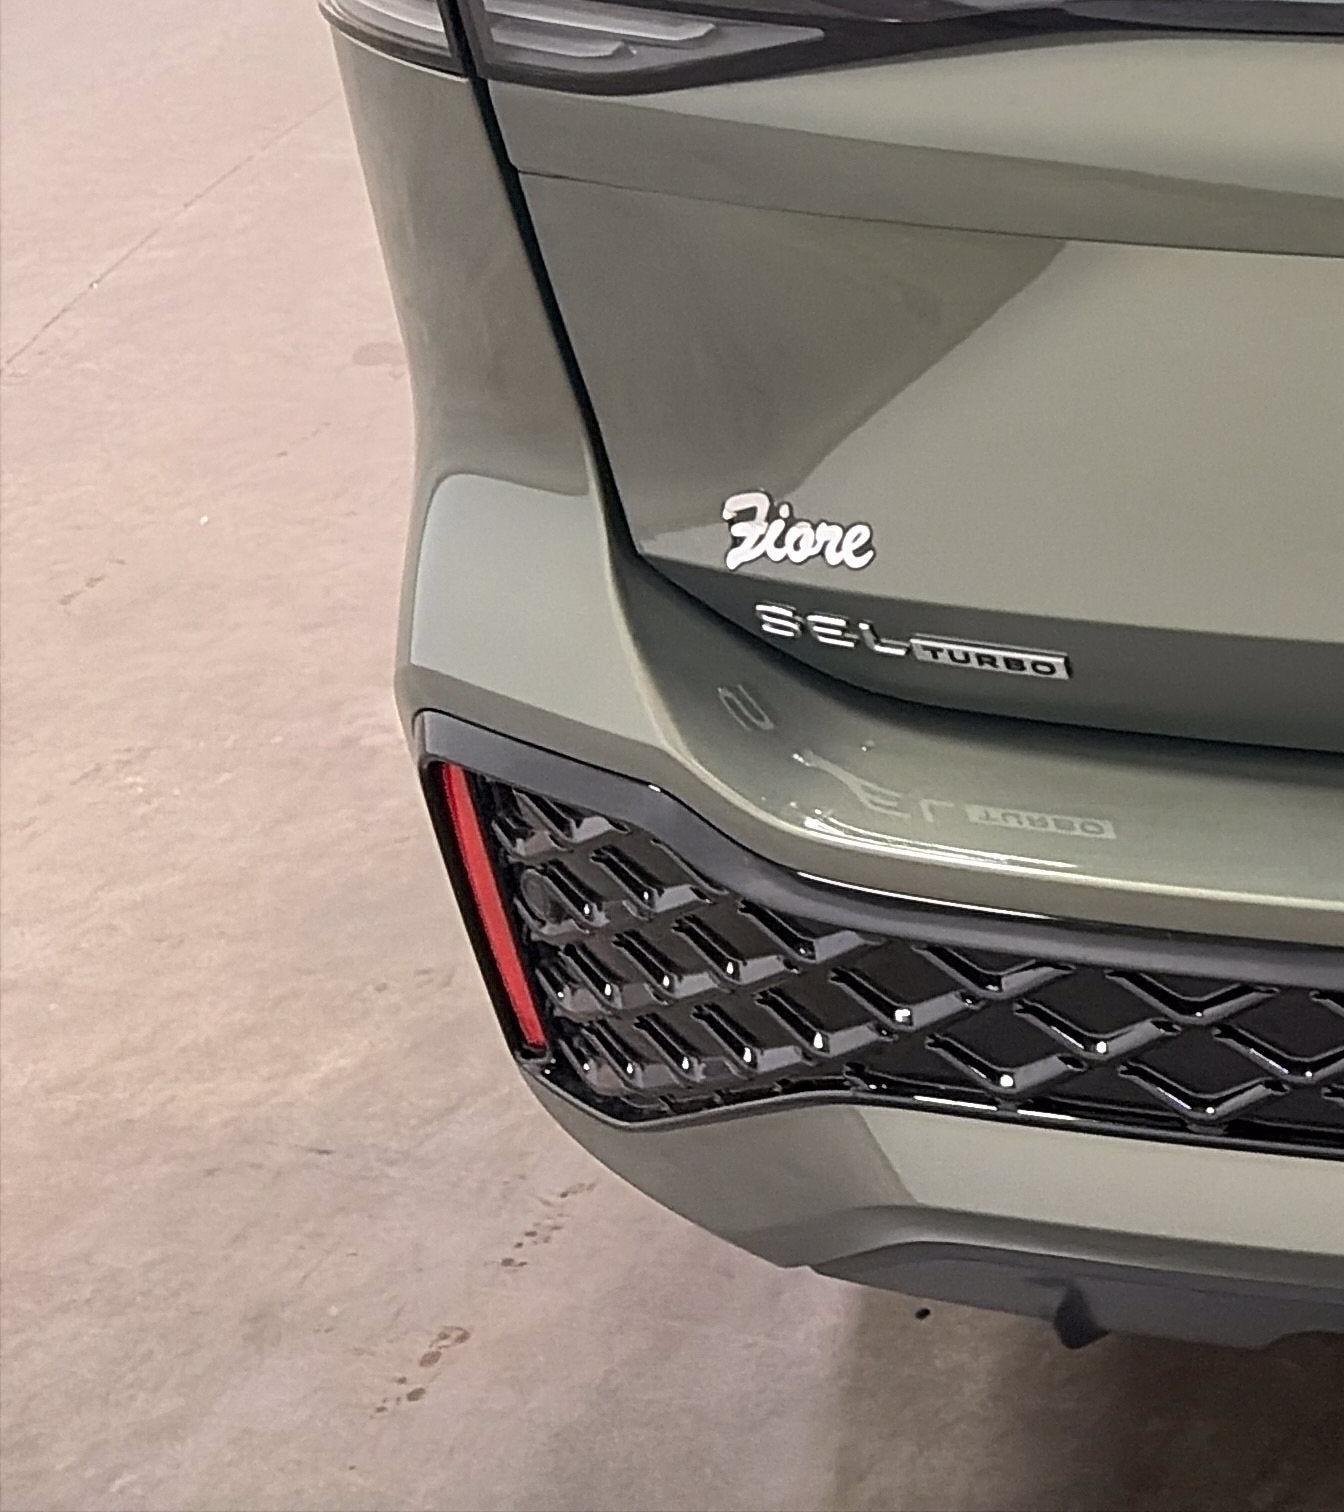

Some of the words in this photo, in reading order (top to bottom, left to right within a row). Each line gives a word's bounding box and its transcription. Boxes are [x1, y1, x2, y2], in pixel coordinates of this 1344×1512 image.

[722, 491, 875, 570] Fiore
[755, 600, 908, 656] SEL
[918, 644, 1061, 679] TURBO
